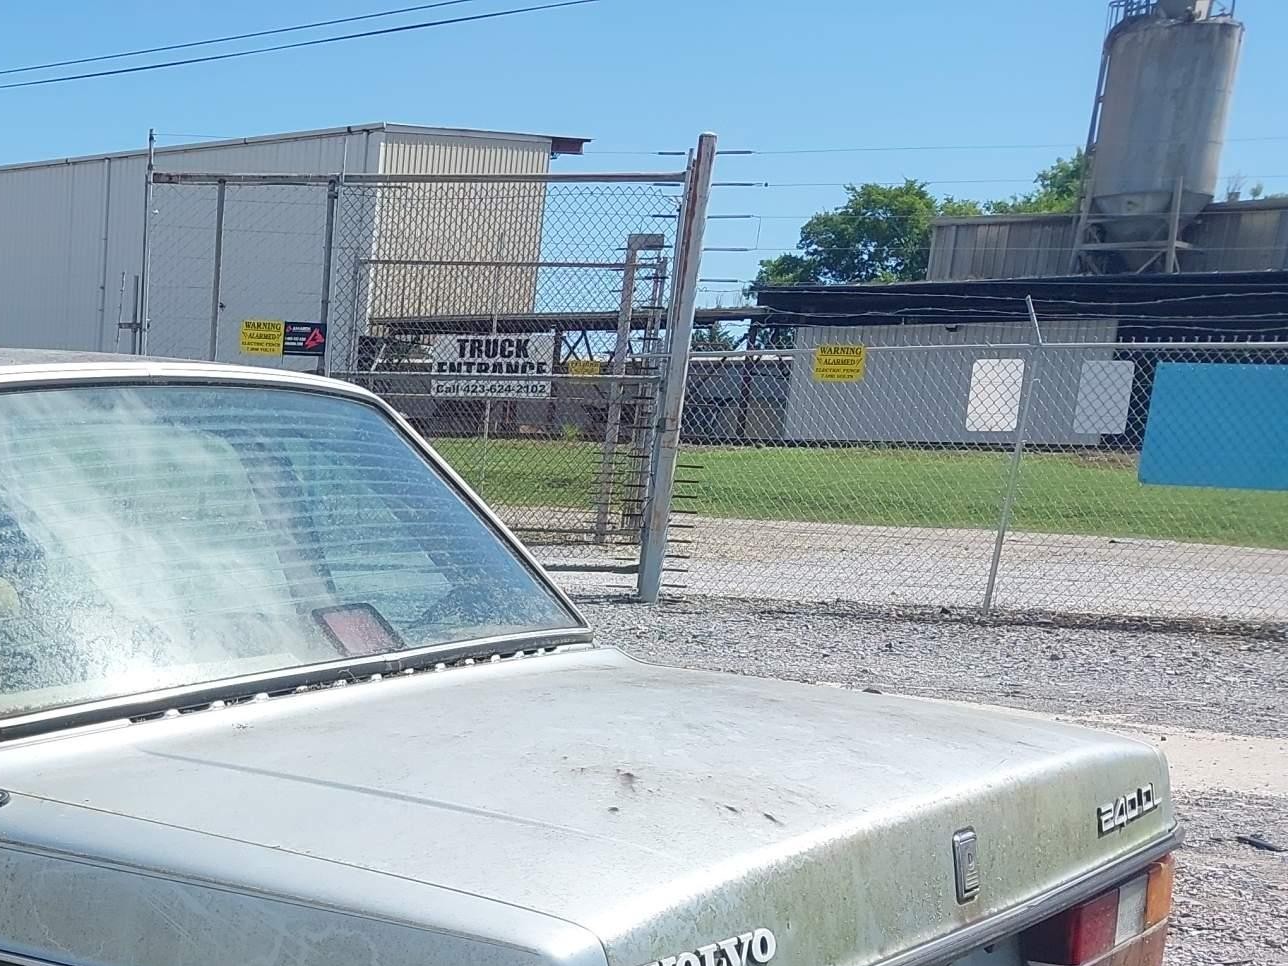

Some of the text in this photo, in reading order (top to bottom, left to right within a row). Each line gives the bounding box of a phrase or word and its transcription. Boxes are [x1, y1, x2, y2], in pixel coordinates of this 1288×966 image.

[244, 321, 282, 331] WARNING
[248, 332, 276, 340] ALARMED
[456, 338, 530, 359] TRUCK
[820, 346, 862, 355] WARNING
[823, 358, 856, 366] ALARMED
[436, 361, 548, 374] ENTRANCE
[435, 384, 547, 394] Call 423-624-2102
[1097, 782, 1163, 834] 240 DL
